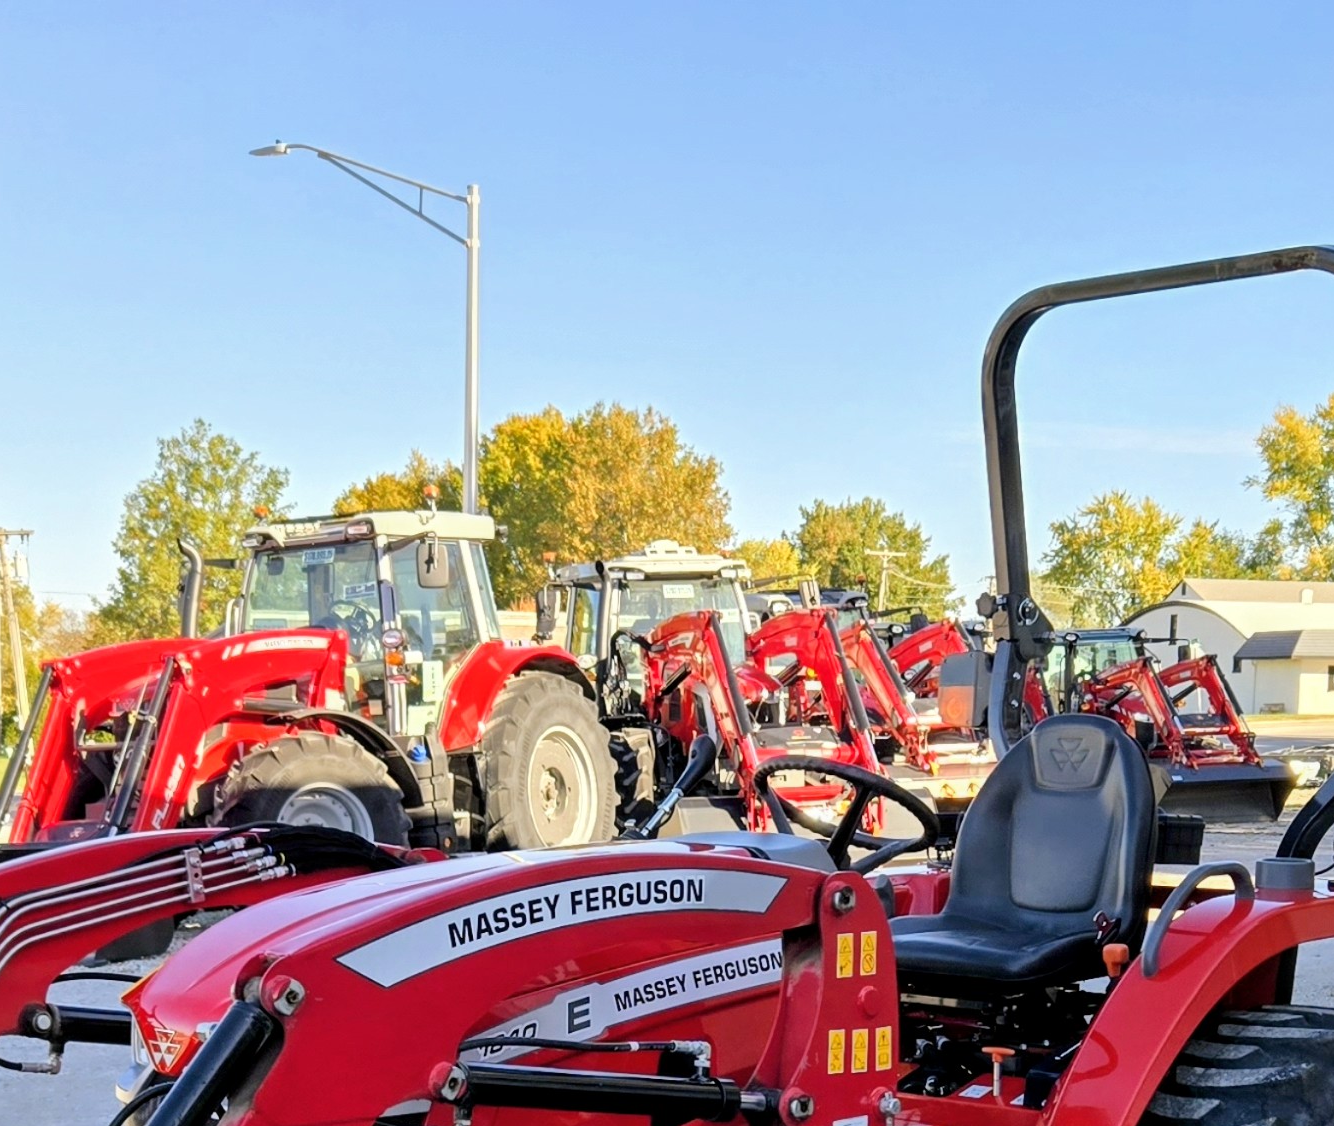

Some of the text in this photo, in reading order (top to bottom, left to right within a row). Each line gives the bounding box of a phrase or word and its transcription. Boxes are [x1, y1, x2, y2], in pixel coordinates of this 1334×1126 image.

[447, 878, 704, 948] MASSEY FERGUSON
[567, 996, 591, 1034] E
[614, 973, 687, 1012] MASSEY
[692, 950, 783, 989] FERGUSON
